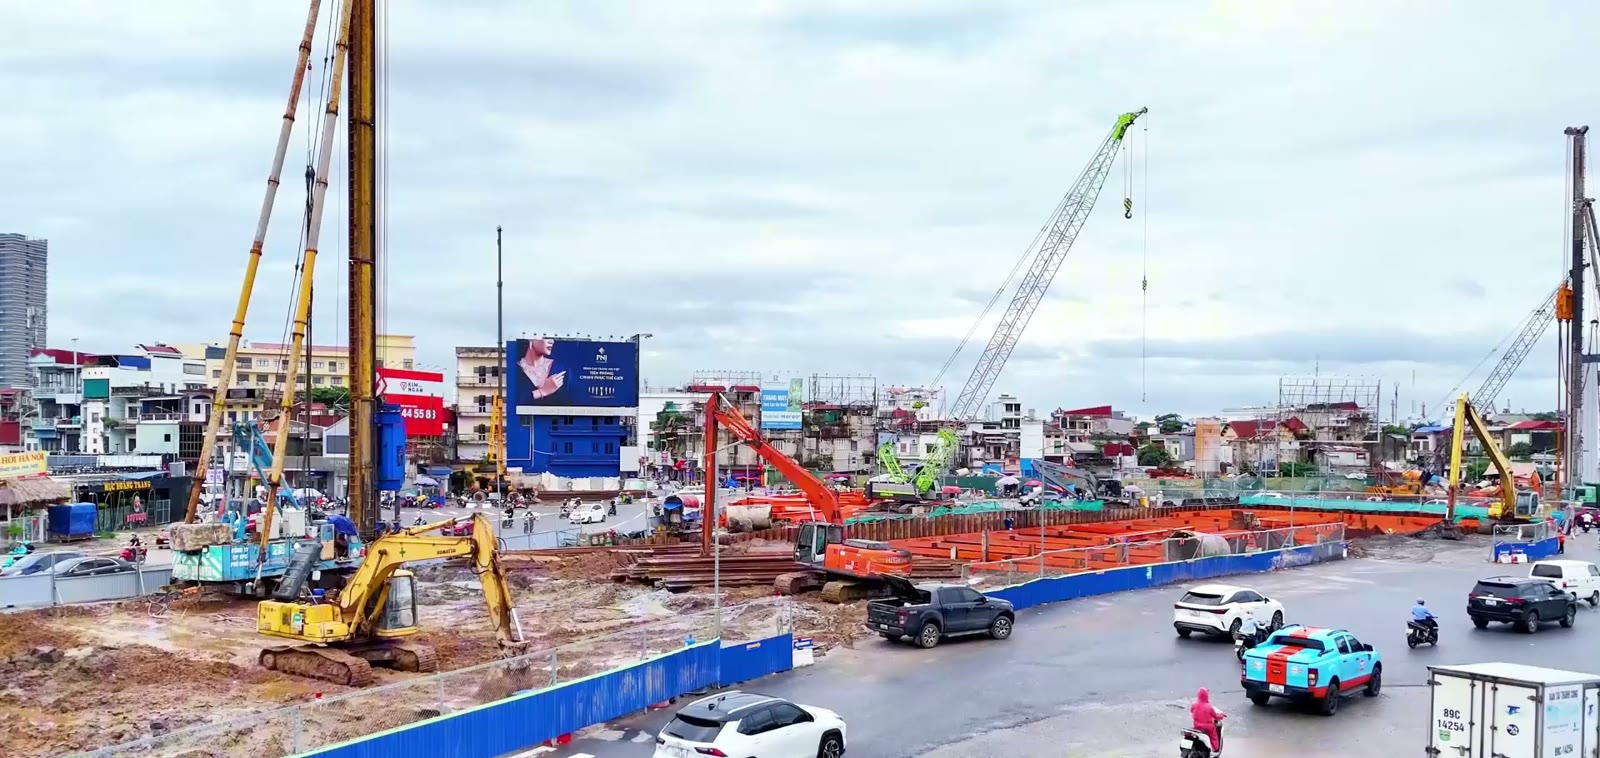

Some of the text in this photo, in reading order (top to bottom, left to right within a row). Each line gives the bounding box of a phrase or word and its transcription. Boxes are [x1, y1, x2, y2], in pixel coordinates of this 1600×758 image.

[596, 354, 608, 362] PNJ
[401, 408, 412, 418] 44
[413, 409, 424, 419] 55
[1443, 708, 1460, 719] 89C
[1438, 719, 1464, 731] 14254
